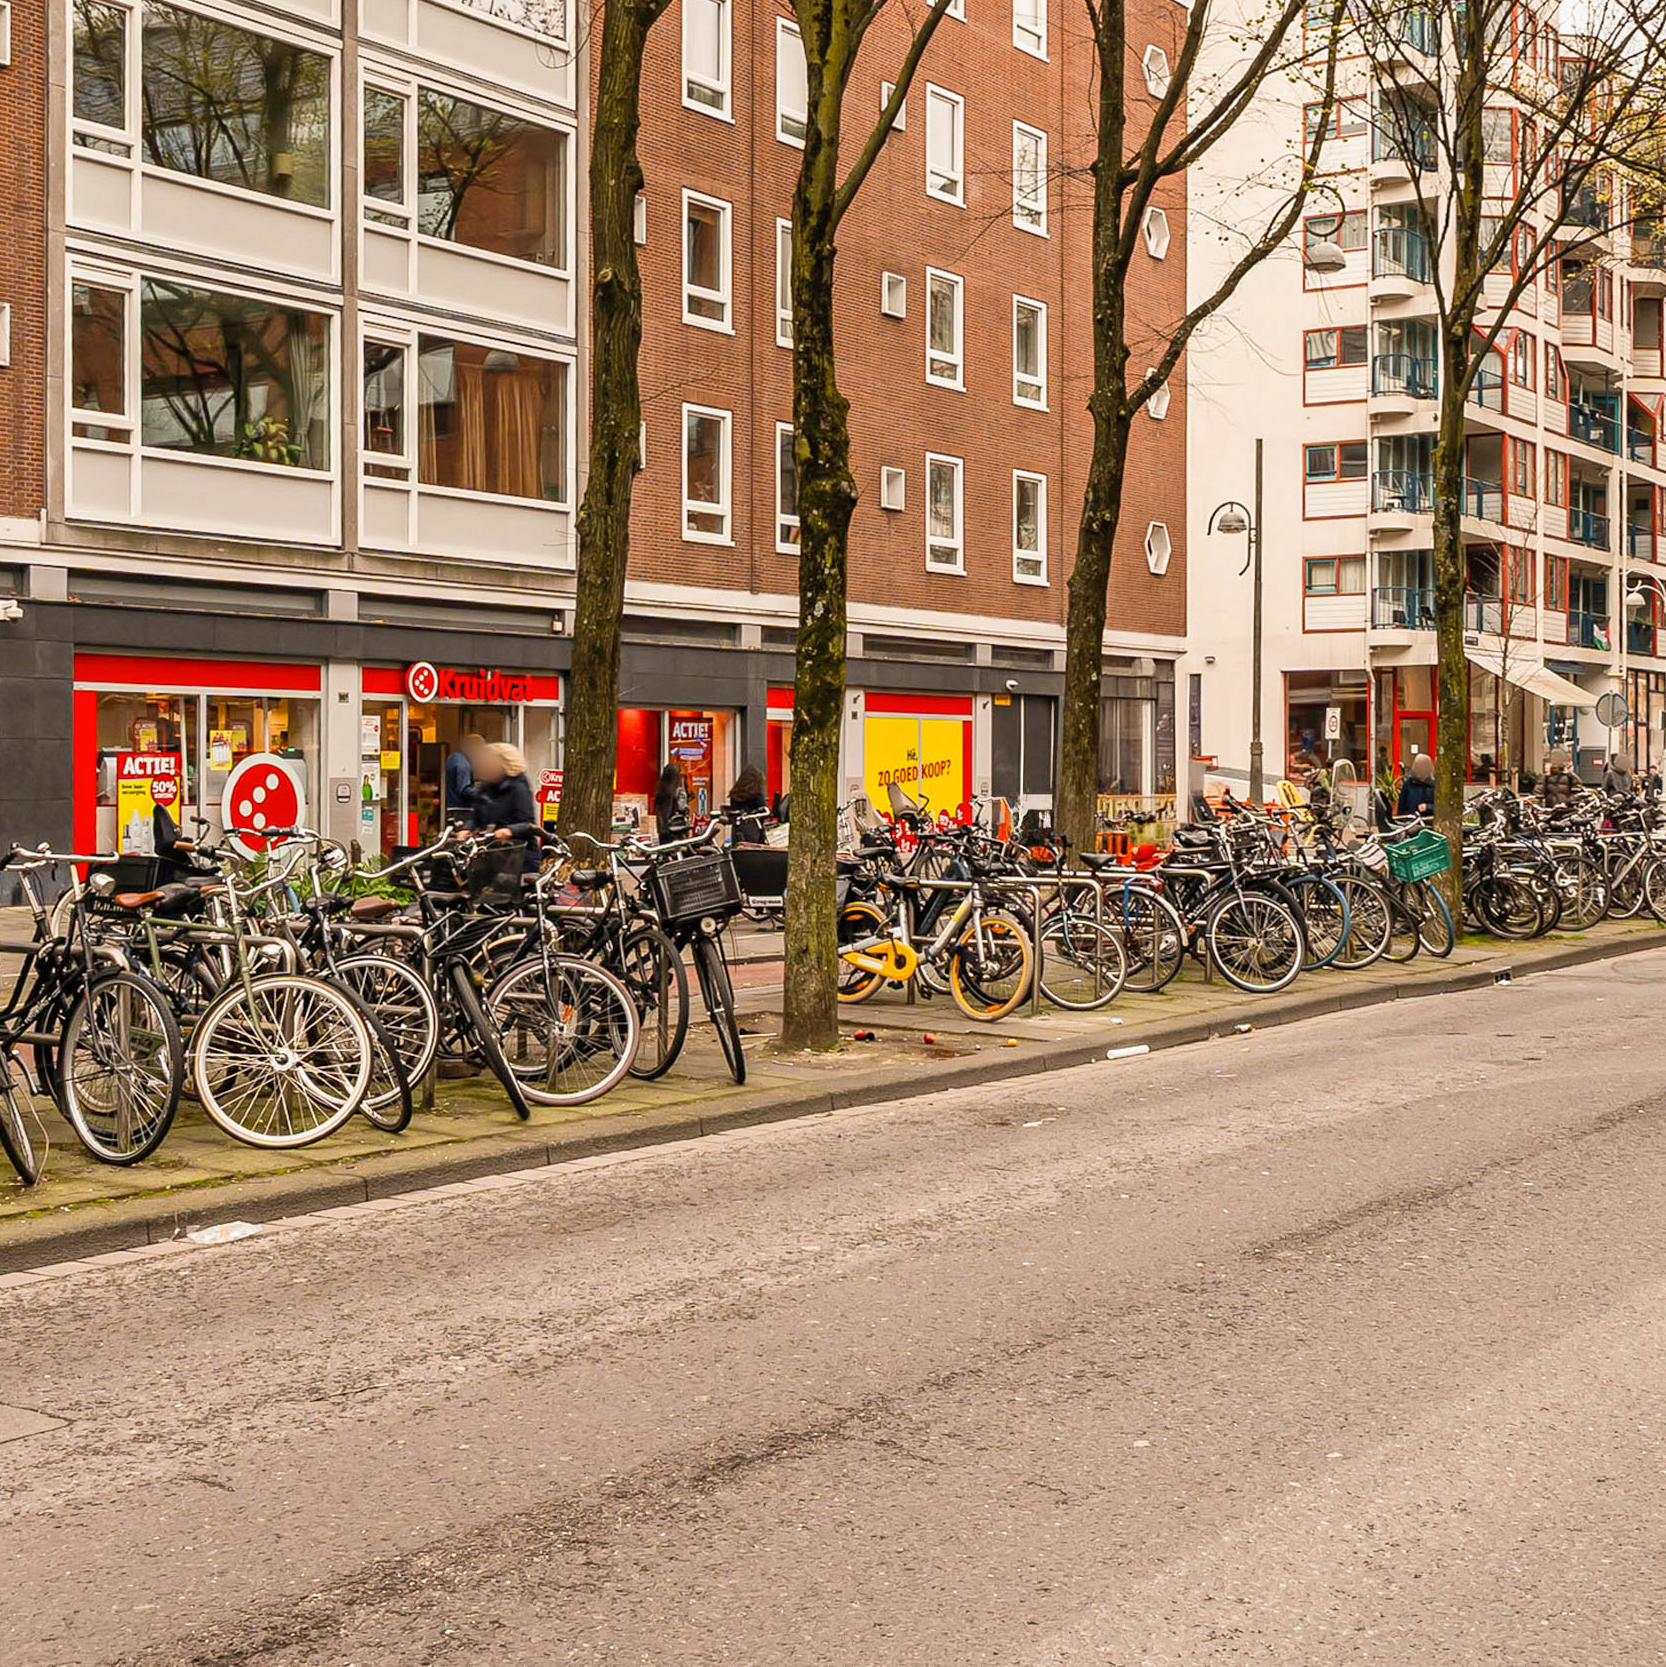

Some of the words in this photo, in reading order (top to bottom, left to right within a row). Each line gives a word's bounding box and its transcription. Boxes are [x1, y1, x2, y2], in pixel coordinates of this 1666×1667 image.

[437, 668, 533, 702] Kruidvat
[672, 721, 709, 739] ACTIE!
[122, 756, 176, 776] ACTIE!
[151, 780, 177, 794] 50%
